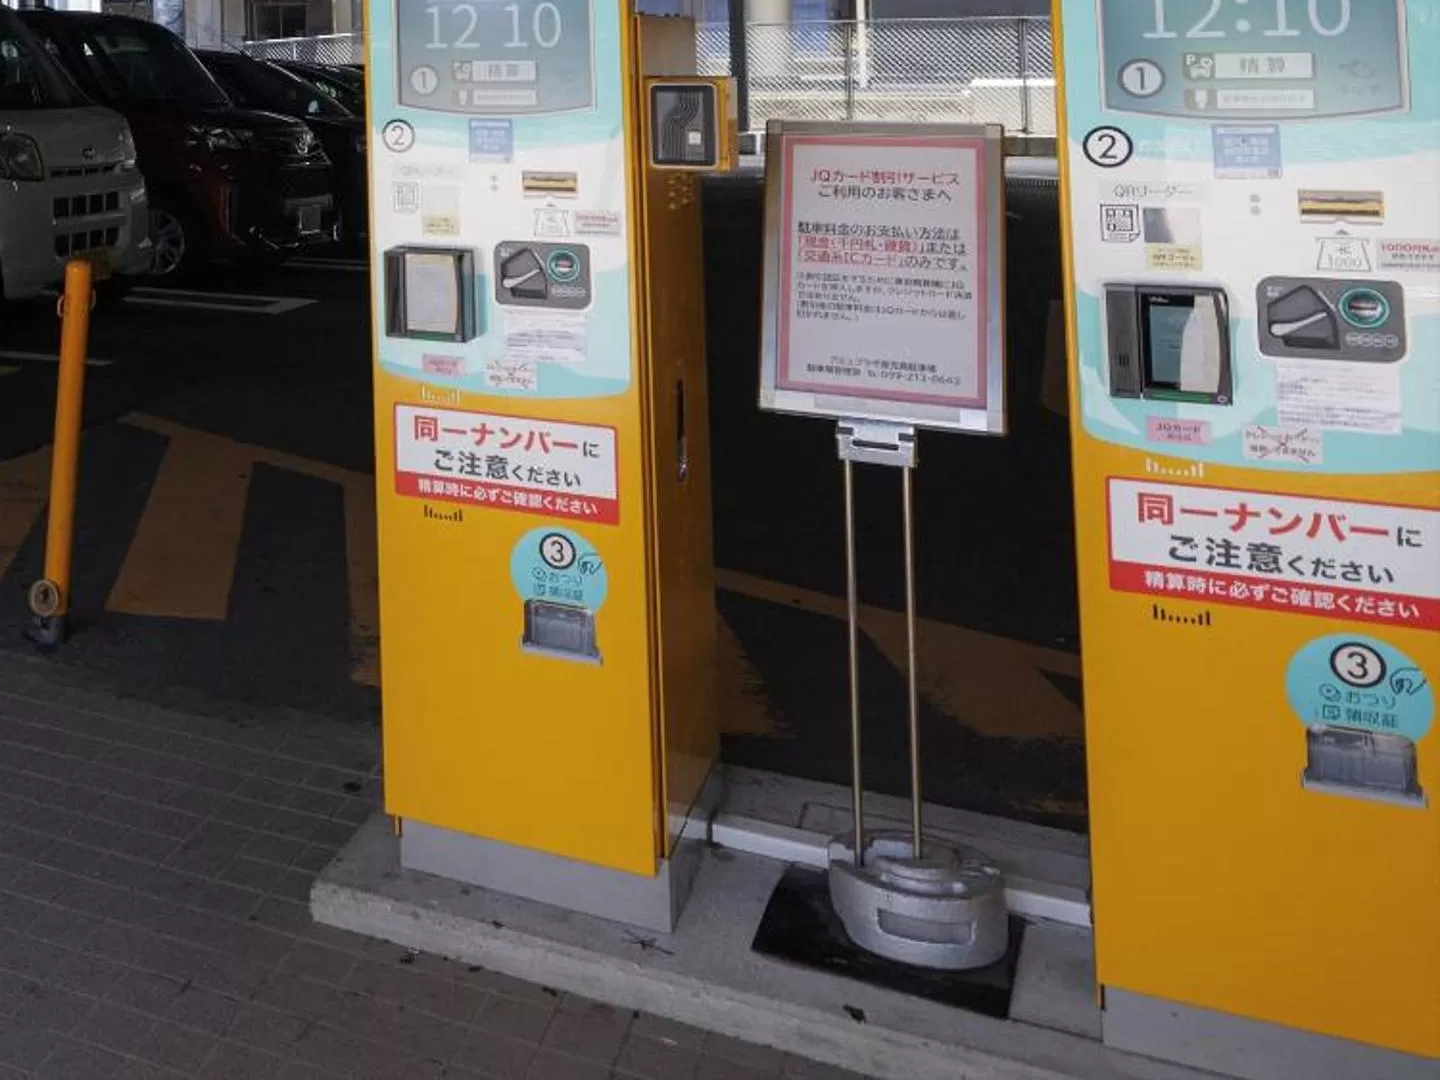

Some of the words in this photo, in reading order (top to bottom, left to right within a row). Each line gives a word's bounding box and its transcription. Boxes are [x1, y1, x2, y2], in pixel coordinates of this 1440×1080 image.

[414, 415, 601, 459] 同一ナンバーに
[434, 449, 581, 488] ご注意ください
[1137, 491, 1423, 549] 同一ナンバーに
[1169, 533, 1395, 585] ご注意ください
[1144, 570, 1420, 620] 精算時に必ずご確認ください
